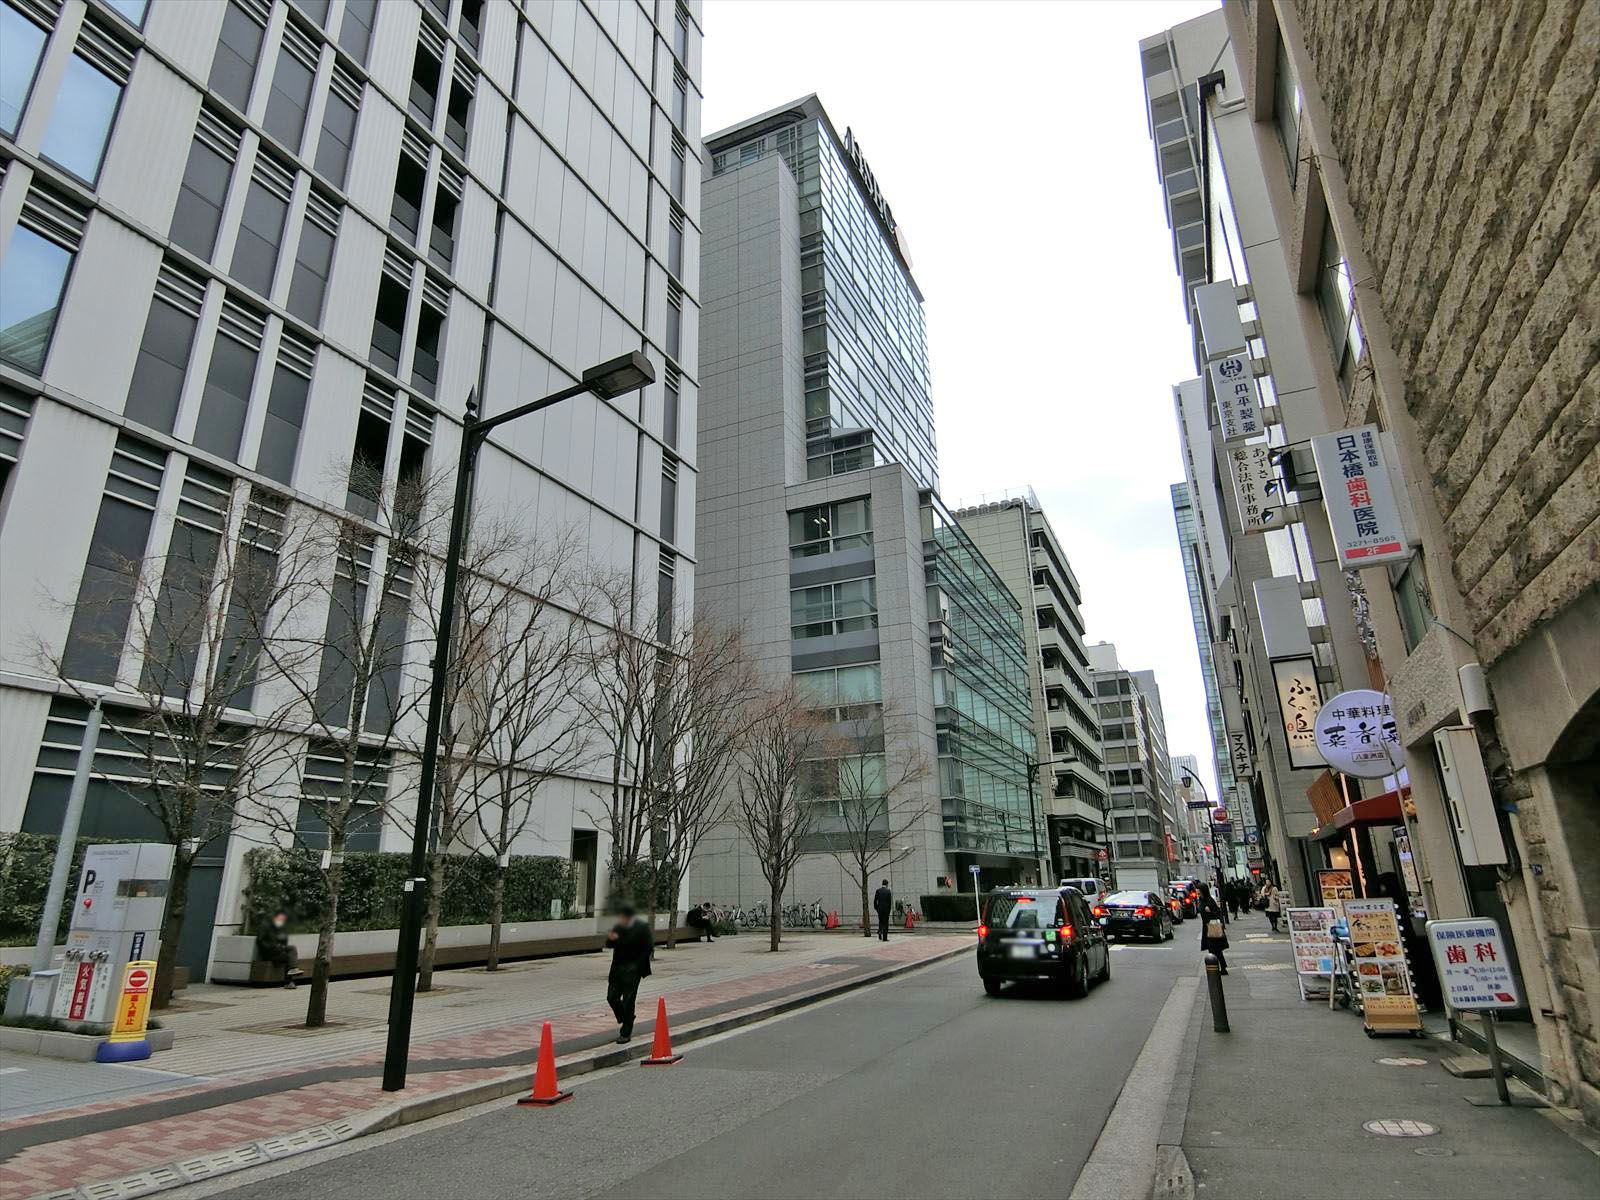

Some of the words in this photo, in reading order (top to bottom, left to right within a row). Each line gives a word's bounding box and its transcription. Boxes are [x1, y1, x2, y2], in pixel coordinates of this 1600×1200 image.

[1221, 400, 1237, 436] 東京支社
[1234, 383, 1256, 433] 丹平製薬
[1252, 447, 1268, 479] あずさ
[1233, 451, 1261, 526] 総合法律事務所
[1336, 435, 1380, 538] 日本橋歯科医院
[1347, 535, 1396, 548] 3271-8565
[1366, 546, 1380, 556] 2F
[1332, 704, 1391, 721] 中華料理
[1231, 733, 1250, 774] マスキチ
[82, 869, 97, 894] P
[1436, 928, 1496, 940] 保険医療機関
[73, 965, 90, 1017] 火気厳禁
